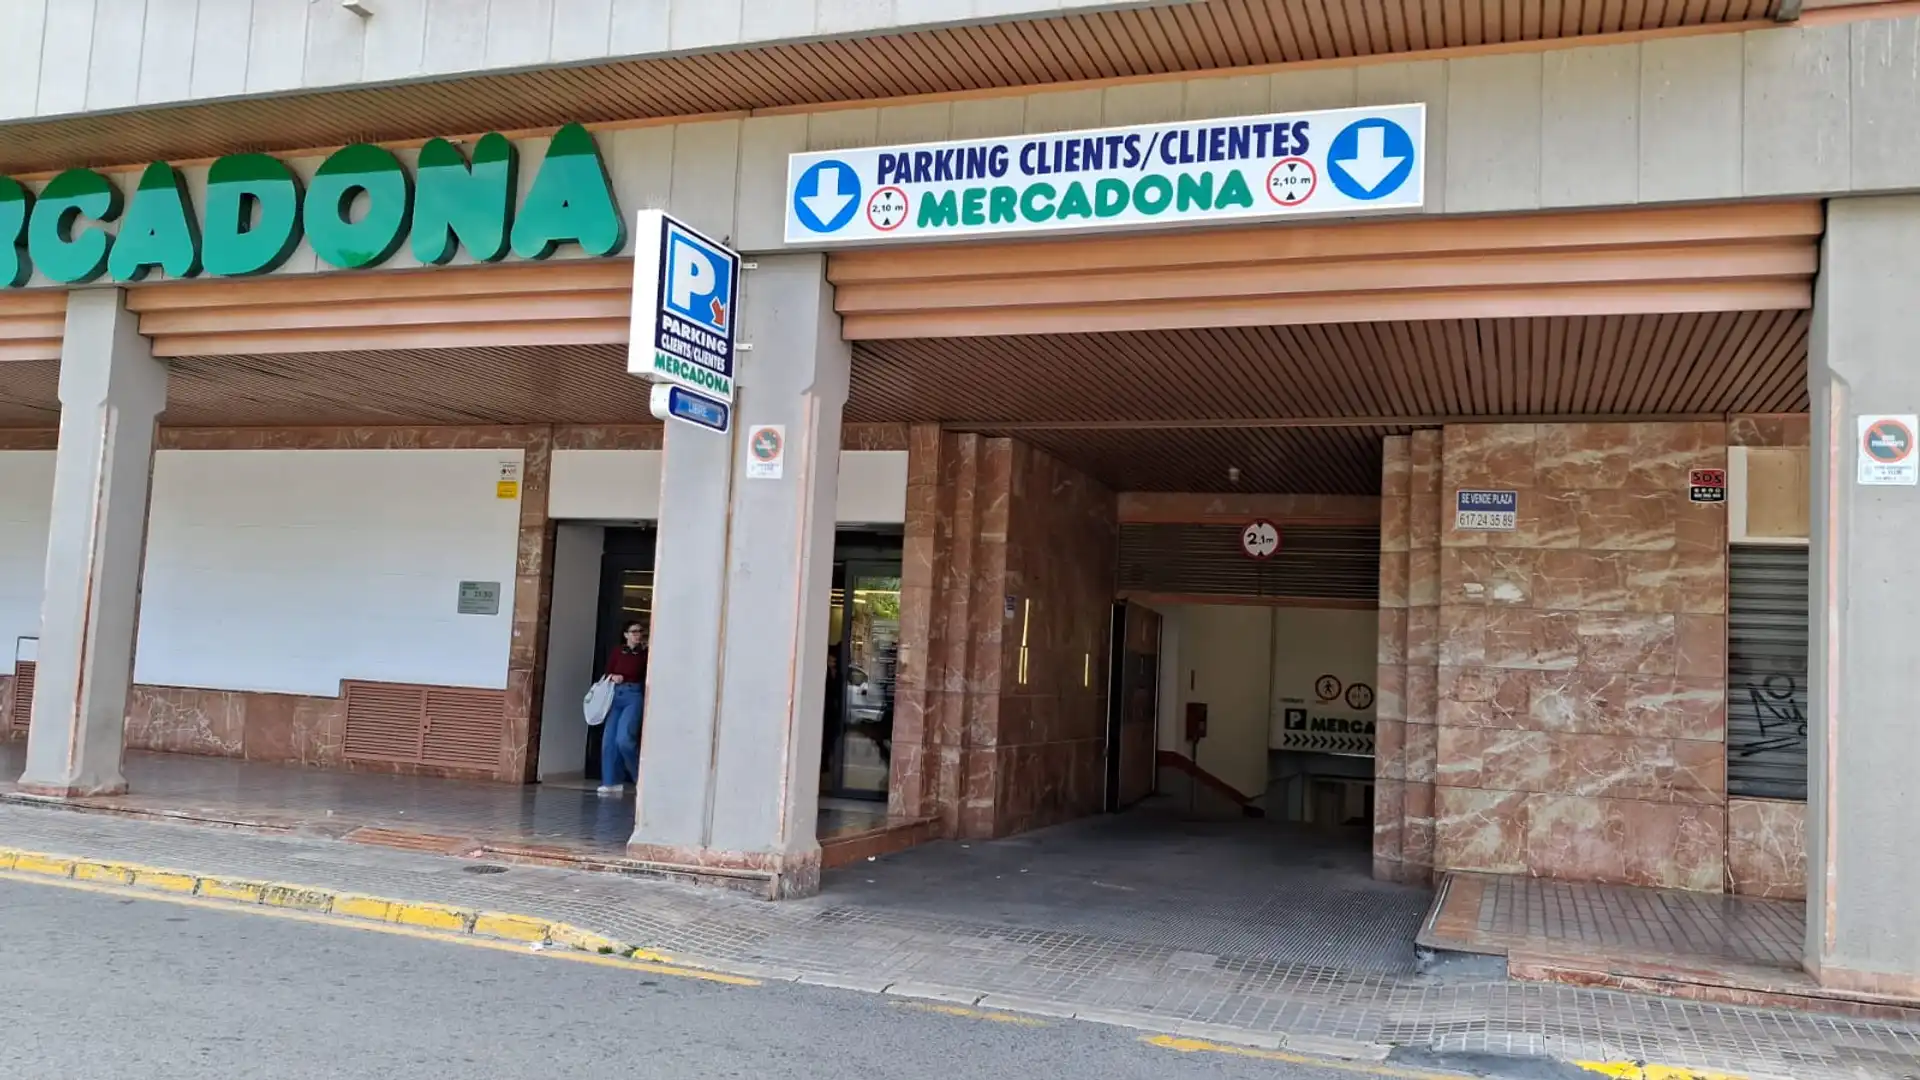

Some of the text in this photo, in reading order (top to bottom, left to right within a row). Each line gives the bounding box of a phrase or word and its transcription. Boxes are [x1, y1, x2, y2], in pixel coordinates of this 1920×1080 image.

[877, 120, 1310, 185] PARKING CLIENTS/CLIENTES
[1272, 176, 1311, 187] 2,10 m
[872, 203, 904, 213] 2,10 m
[917, 169, 1254, 228] MERCADONA
[671, 239, 716, 310] P
[662, 314, 728, 355] PARKING
[654, 351, 730, 395] MERCADONA
[1461, 492, 1513, 505] SE VENDE PLAZA
[1460, 512, 1514, 527] 617 24 35 89
[1289, 711, 1302, 728] P
